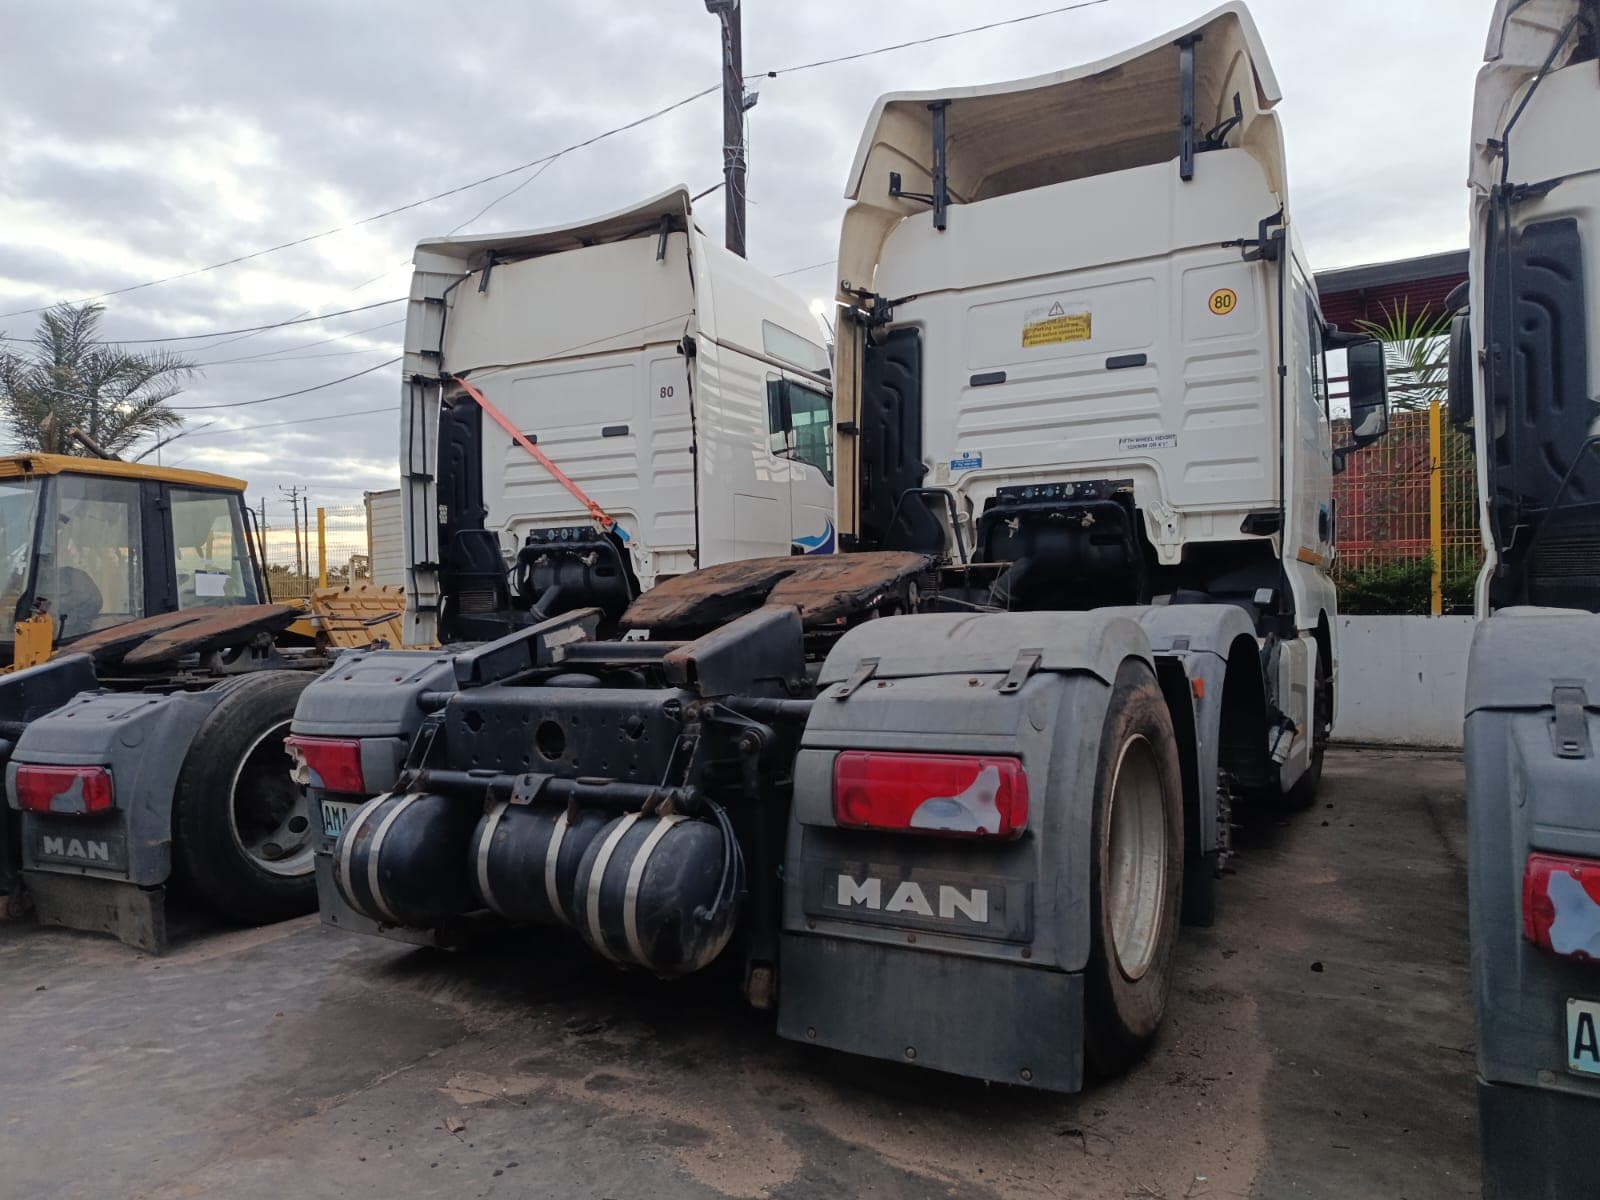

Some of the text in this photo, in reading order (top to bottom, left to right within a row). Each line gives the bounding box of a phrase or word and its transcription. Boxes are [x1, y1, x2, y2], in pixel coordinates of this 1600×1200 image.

[1215, 294, 1231, 309] 80
[660, 386, 674, 398] 80
[43, 836, 109, 860] MAN
[838, 874, 988, 923] MAN
